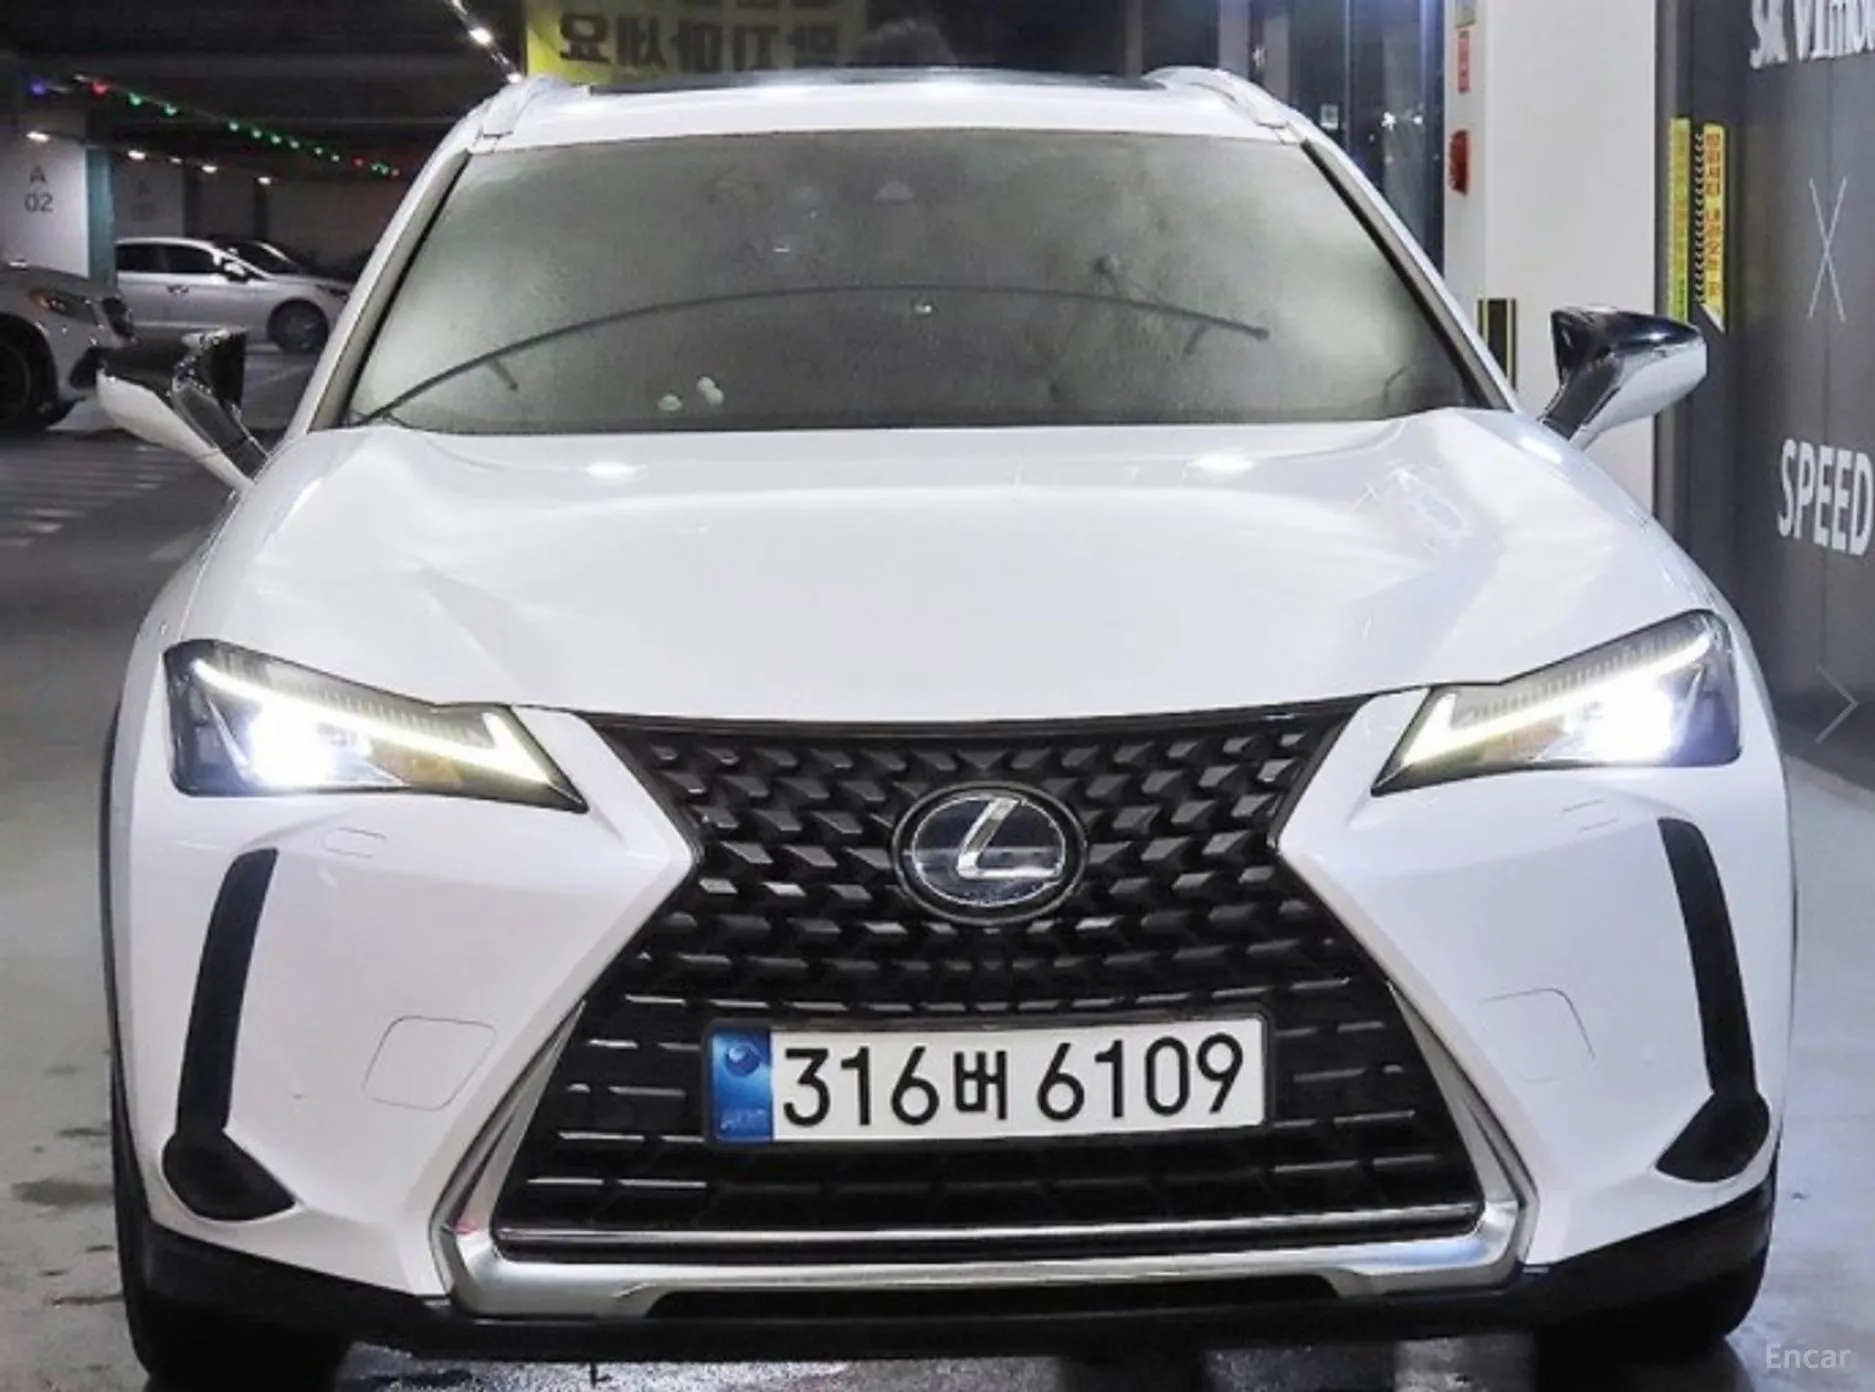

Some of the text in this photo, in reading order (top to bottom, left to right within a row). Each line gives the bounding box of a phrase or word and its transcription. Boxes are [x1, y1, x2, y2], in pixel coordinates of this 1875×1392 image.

[24, 191, 54, 212] 02
[29, 165, 49, 185] A
[1777, 438, 1874, 556] SPEED
[783, 1032, 1244, 1128] 316버 6109
